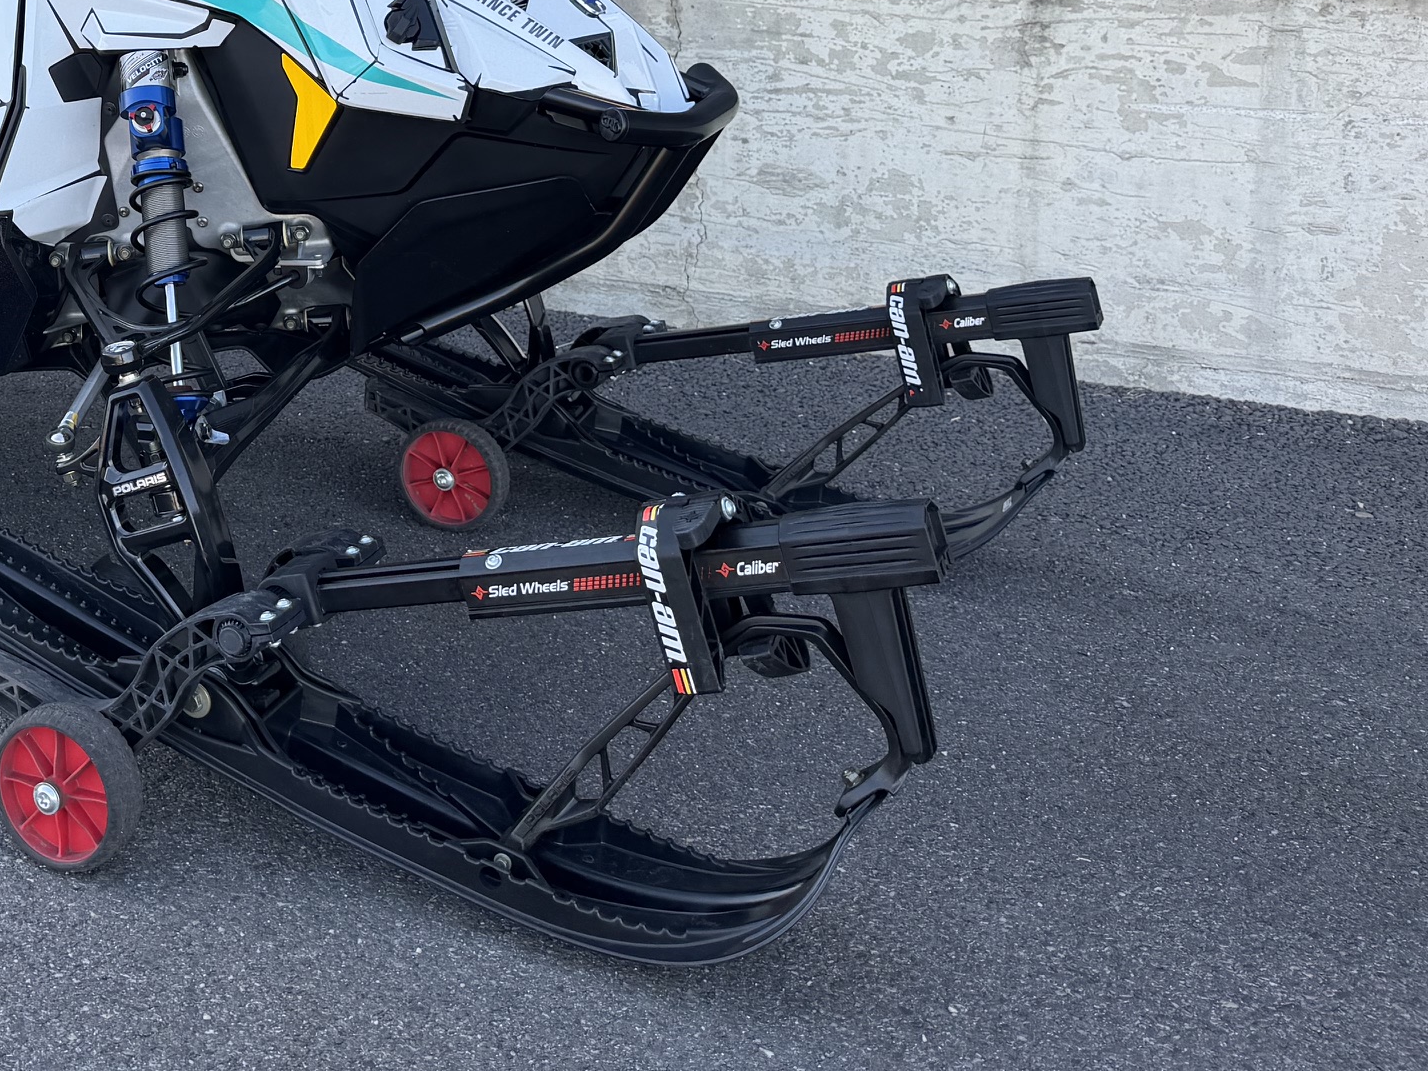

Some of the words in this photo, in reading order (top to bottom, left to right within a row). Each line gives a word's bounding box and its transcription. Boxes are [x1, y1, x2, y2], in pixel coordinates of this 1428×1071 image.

[520, 17, 565, 50] TWIN
[126, 56, 164, 83] VELOCITY
[953, 316, 985, 329] Caliber
[770, 338, 793, 349] Sled
[795, 334, 831, 347] Wheels
[888, 294, 923, 386] can-am
[113, 472, 167, 497] POLARIS
[736, 561, 779, 577] Caliber
[488, 584, 517, 598] Sled
[520, 579, 569, 595] Wheels
[637, 525, 687, 663] can-am
